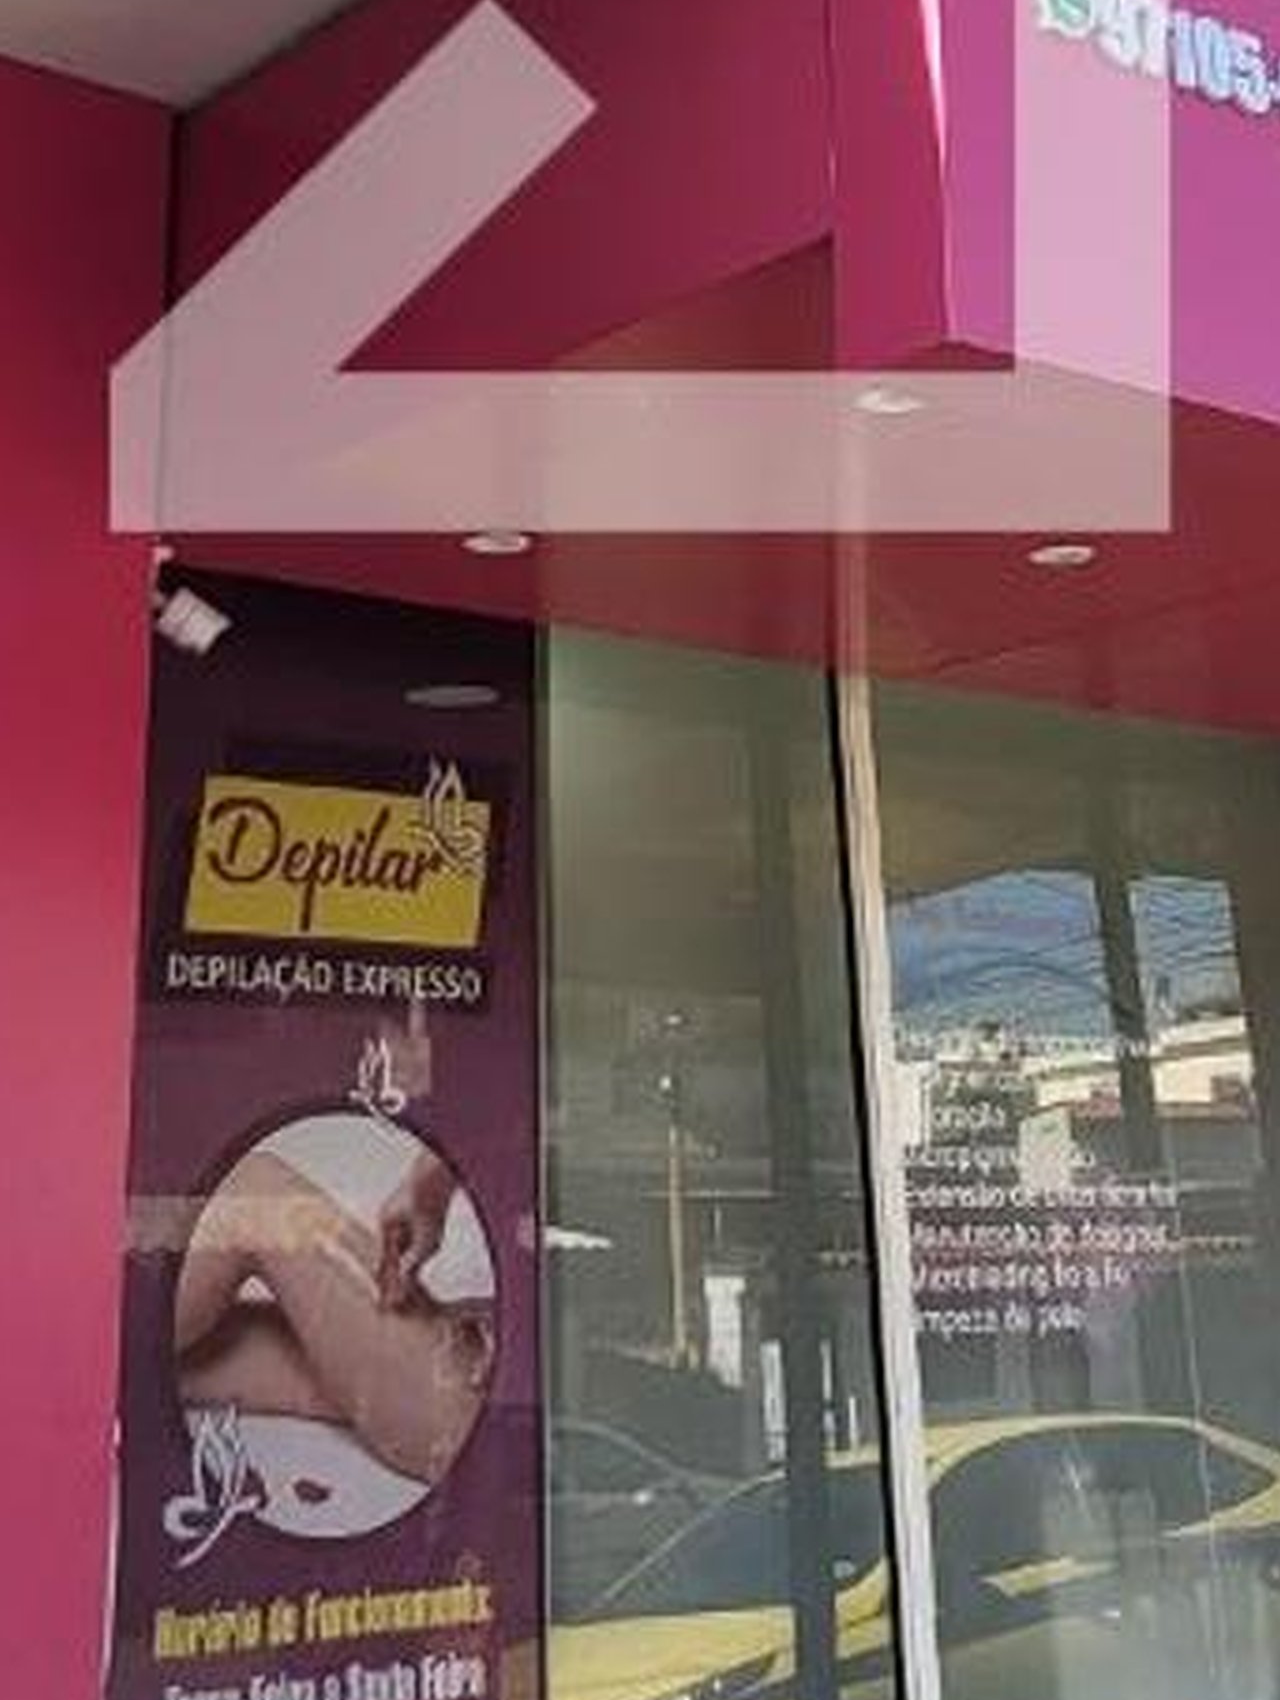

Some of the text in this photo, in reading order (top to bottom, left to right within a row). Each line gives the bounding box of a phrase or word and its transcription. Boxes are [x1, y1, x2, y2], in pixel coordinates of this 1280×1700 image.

[206, 796, 442, 933] Depilar
[167, 950, 482, 1003] DEPILAÇÃO EXPRESSO
